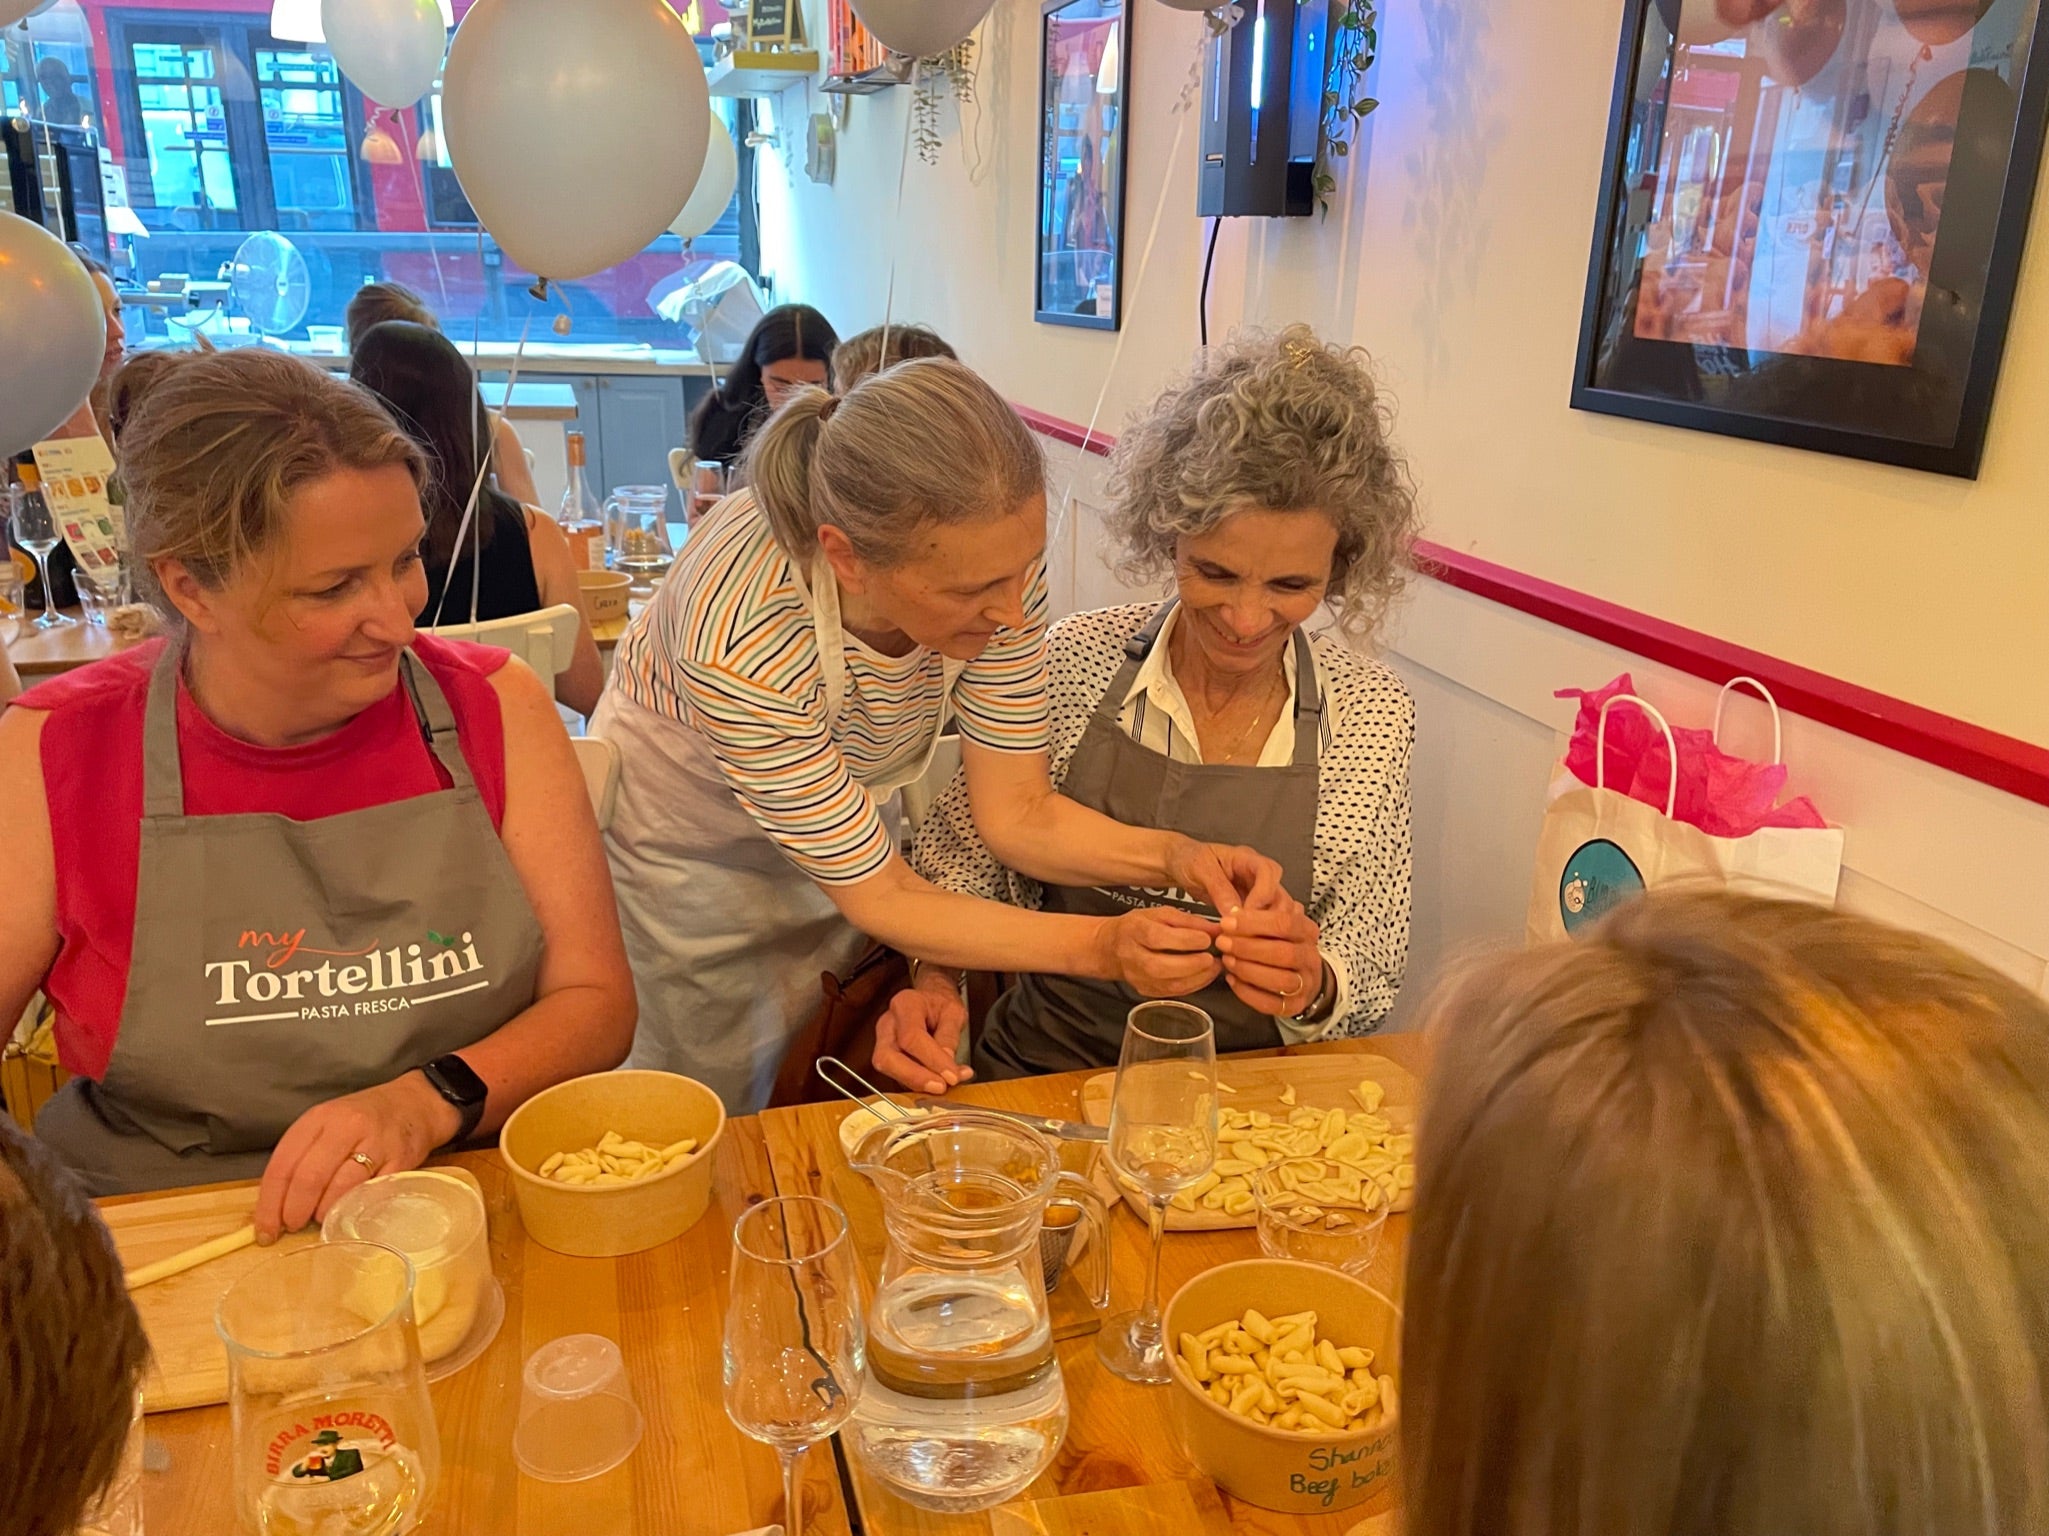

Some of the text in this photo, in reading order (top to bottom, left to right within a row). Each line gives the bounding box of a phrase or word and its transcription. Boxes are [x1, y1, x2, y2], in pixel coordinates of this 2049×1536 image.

[1111, 891, 1147, 909] PASTA
[204, 931, 484, 1005] Tortellini
[301, 996, 410, 1020] PASTA FRESCA
[266, 1411, 397, 1476] BIRRA MORETTI
